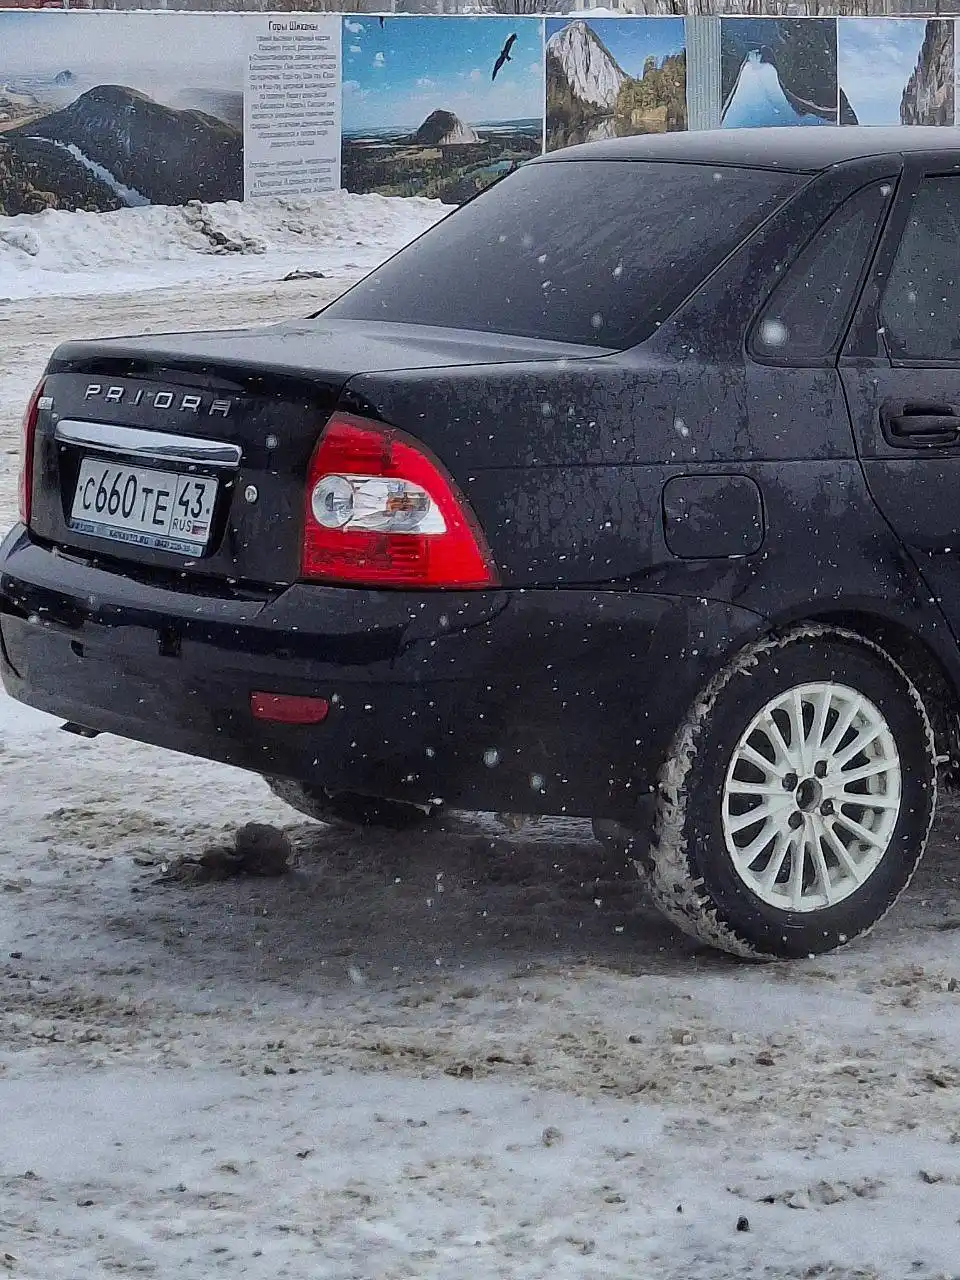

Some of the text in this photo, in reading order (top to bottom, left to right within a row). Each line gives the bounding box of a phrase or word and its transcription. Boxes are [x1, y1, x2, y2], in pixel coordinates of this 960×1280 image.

[83, 384, 232, 418] PRIORA
[178, 480, 206, 519] 43
[172, 518, 193, 533] RUS
